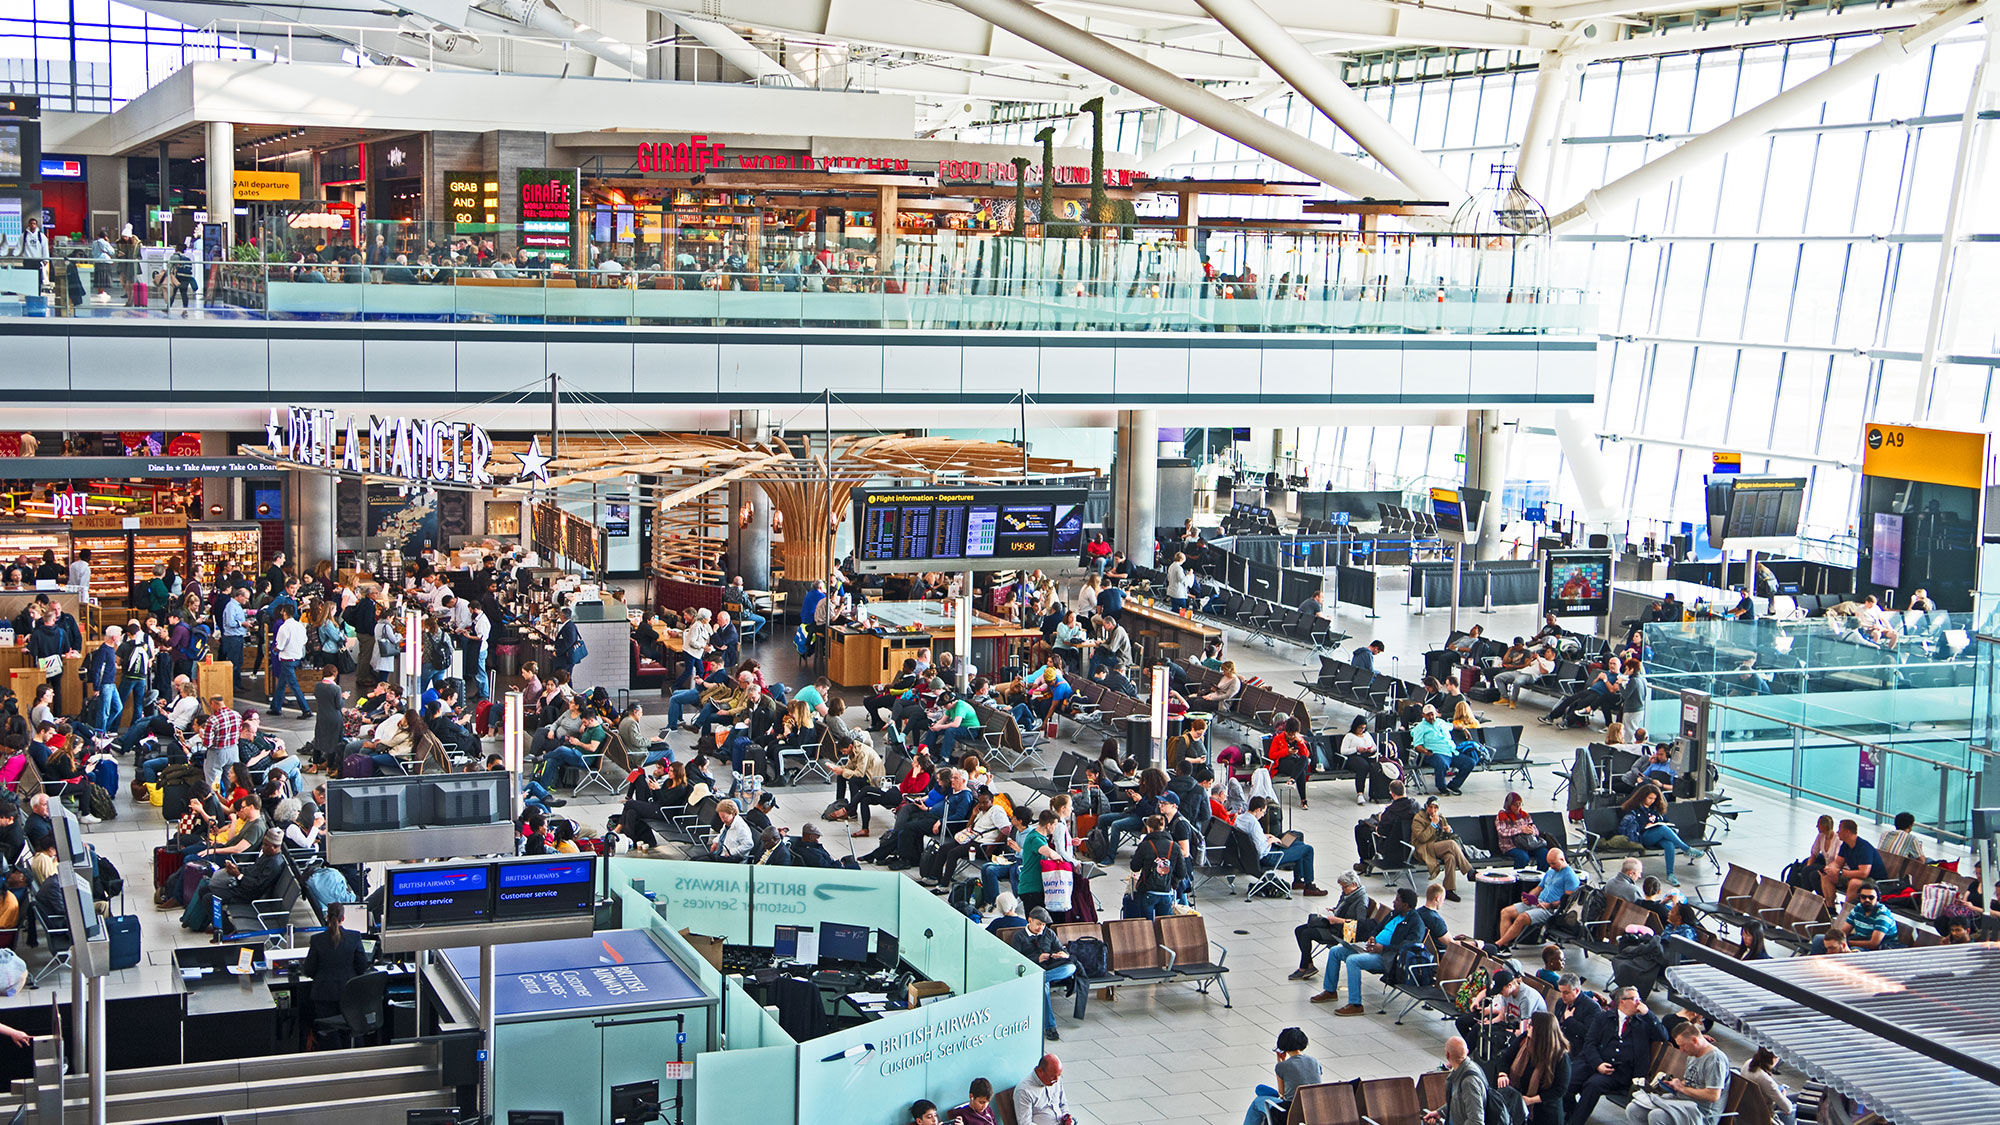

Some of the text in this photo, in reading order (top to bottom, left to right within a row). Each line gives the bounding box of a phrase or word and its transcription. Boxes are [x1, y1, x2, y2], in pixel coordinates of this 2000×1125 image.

[637, 135, 725, 173] GIRAFFE
[823, 156, 908, 172] KITCHEN
[939, 160, 982, 180] FOOD
[1036, 166, 1090, 184] AOUND
[238, 189, 260, 197] gates
[251, 181, 290, 190] departure
[450, 182, 478, 193] GRAB
[522, 179, 570, 203] GIRAFFE
[453, 198, 475, 208] AND
[545, 203, 570, 211] KITCHEN
[456, 213, 472, 223] GO
[555, 210, 569, 218] FOOD
[288, 405, 493, 485] PRET A MANGER
[1886, 432, 1904, 448] A9
[201, 464, 221, 472] Away
[229, 463, 246, 471] Take
[259, 463, 277, 471] Boar
[53, 492, 88, 515] PRET
[876, 494, 974, 503] Flight Information Departures
[394, 897, 453, 908] Customer service
[501, 890, 558, 900] Customer service
[518, 973, 547, 995] Central
[561, 970, 592, 998] Customer
[590, 968, 628, 996] AIRWAYS
[612, 966, 648, 993] BRITISH
[880, 1007, 991, 1055] BRITISH AIRWAYS
[880, 1049, 936, 1077] Customer
[938, 1035, 984, 1059] Services
[993, 1015, 1032, 1040] Central
